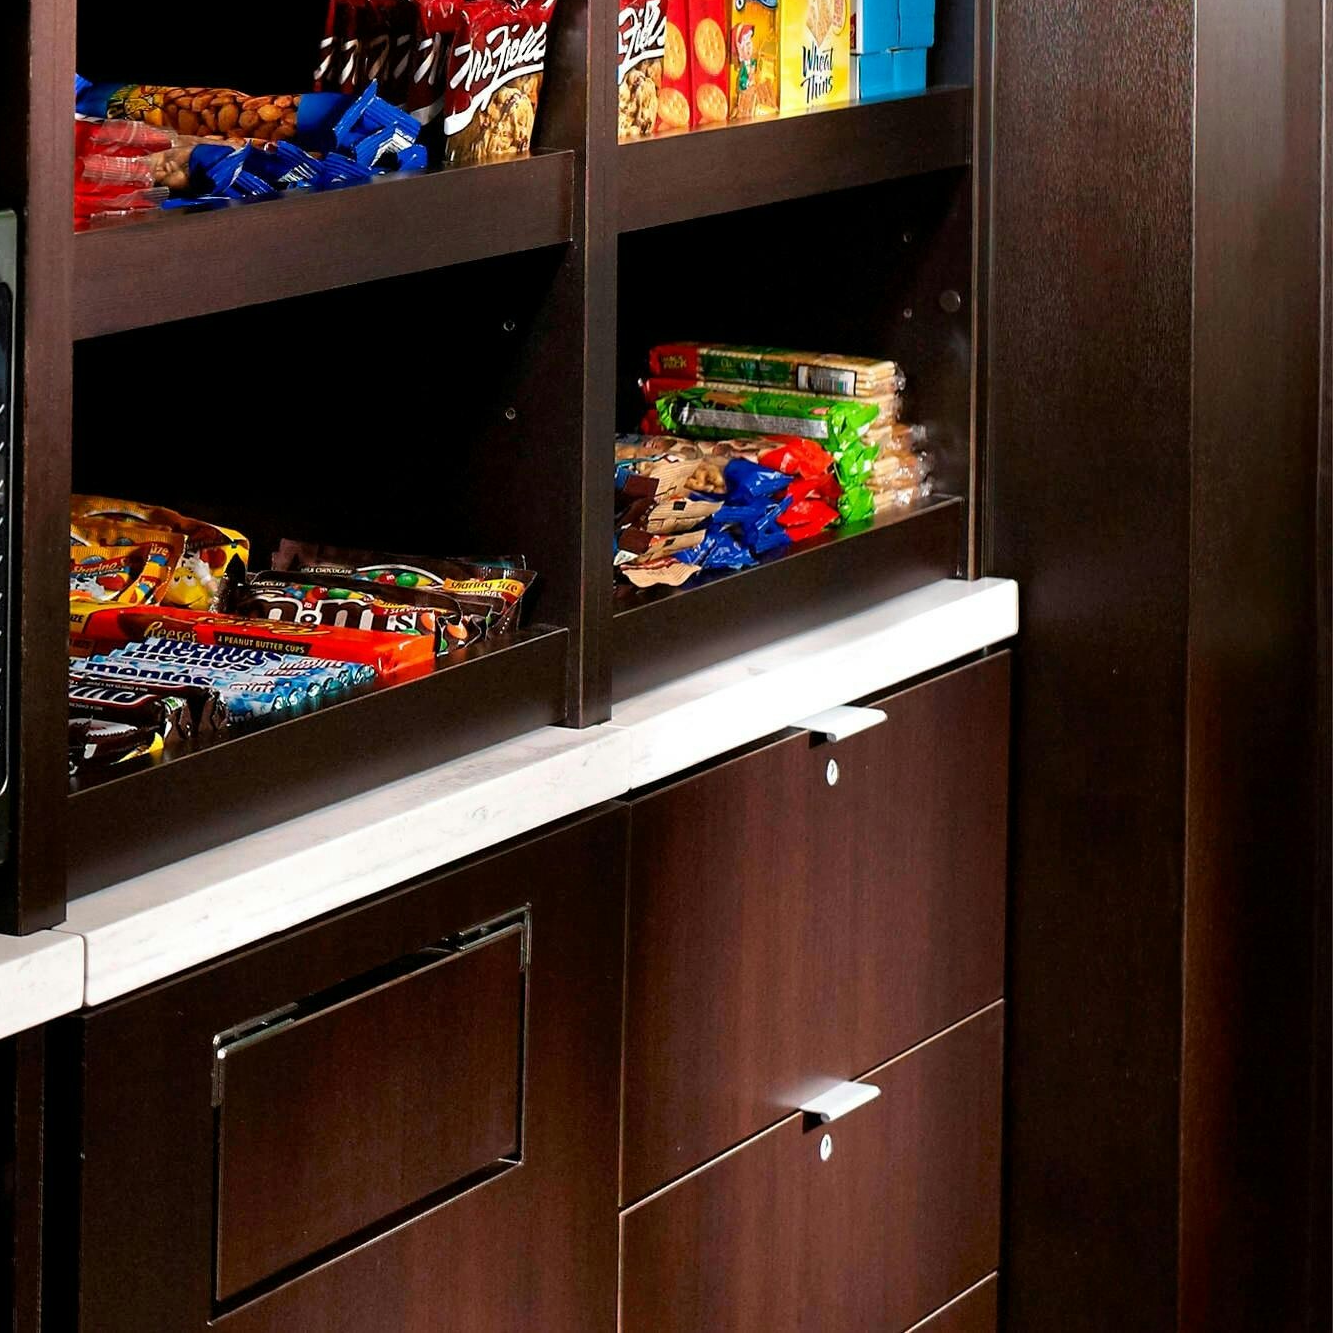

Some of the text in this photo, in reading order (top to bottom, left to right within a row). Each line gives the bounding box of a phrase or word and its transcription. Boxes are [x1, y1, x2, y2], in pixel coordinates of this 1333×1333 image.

[802, 42, 834, 78] Wheat
[801, 74, 834, 104] Thins
[144, 621, 198, 643] Reese's
[224, 636, 254, 647] PEANUT
[255, 640, 283, 651] BUTTER
[284, 644, 306, 654] CUPS
